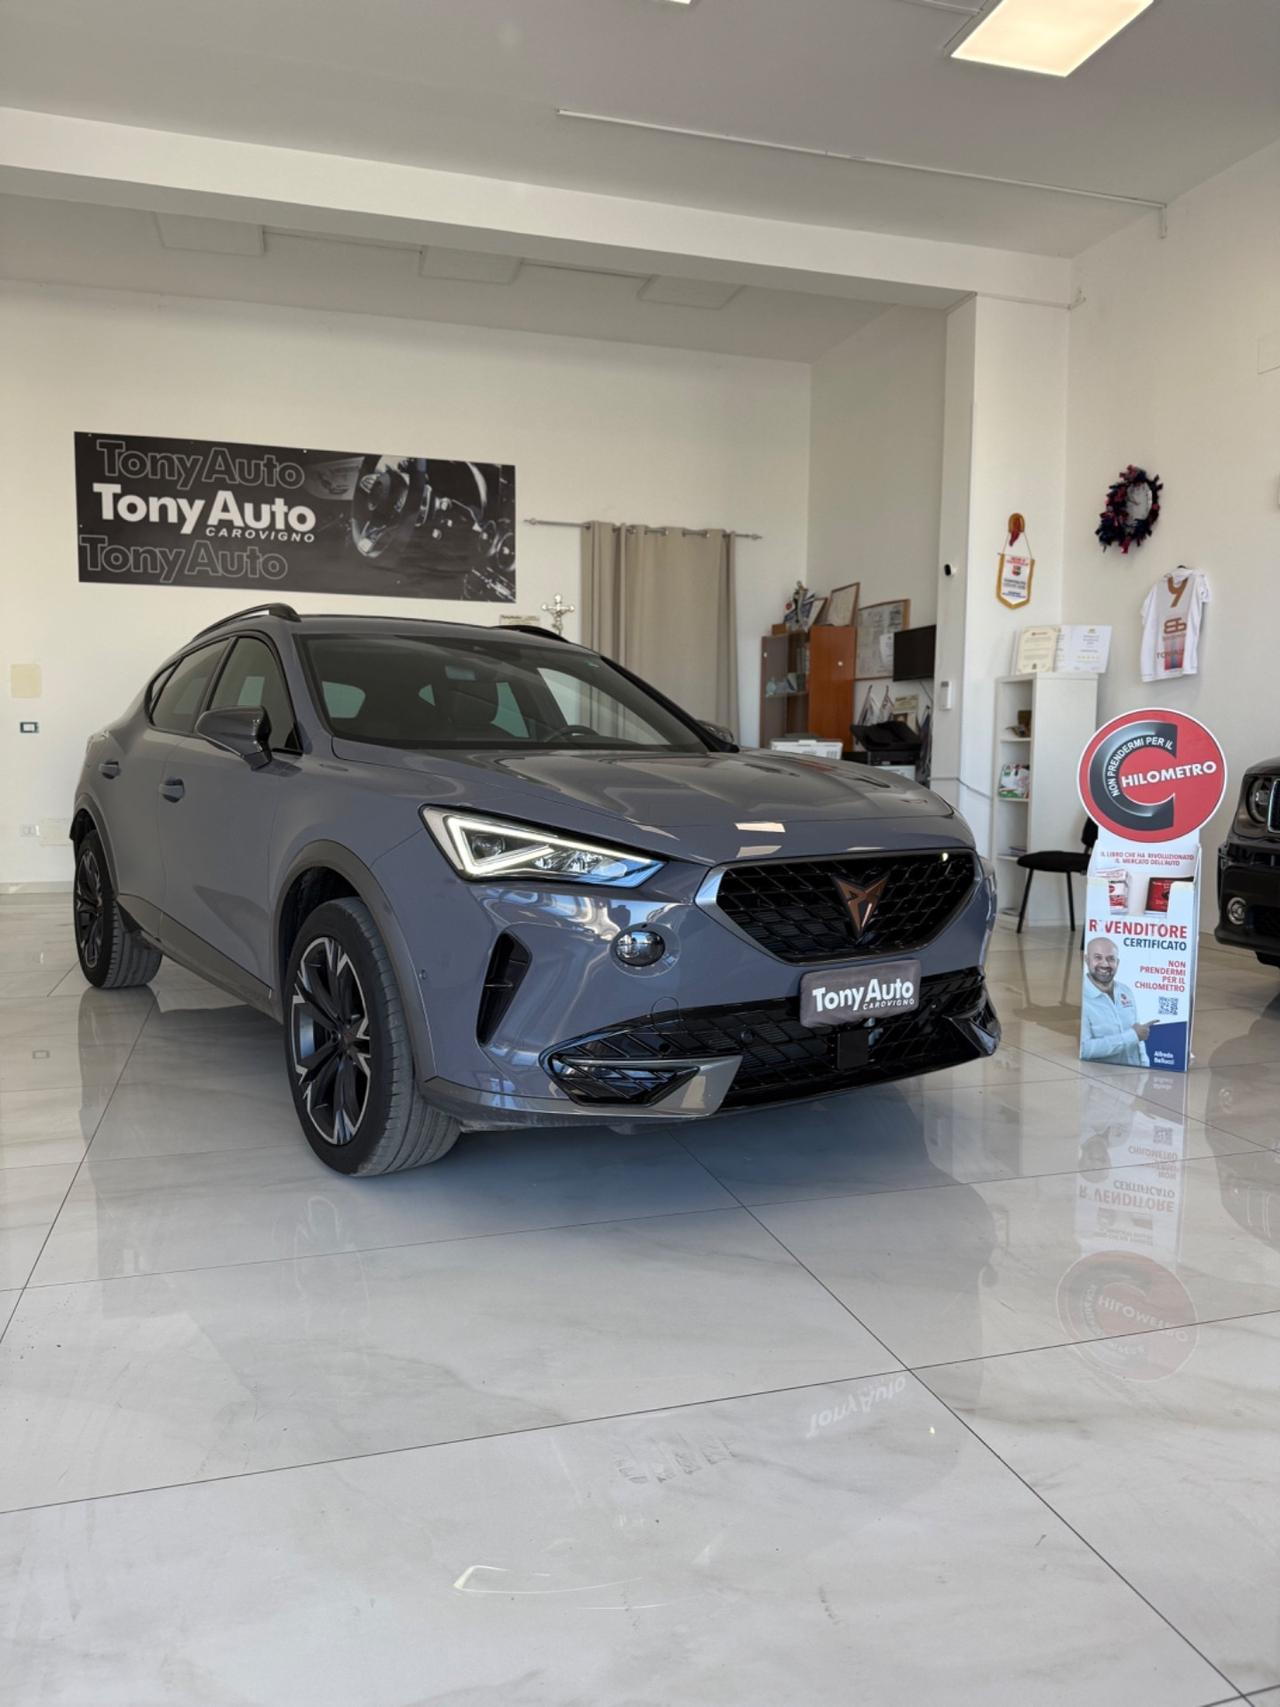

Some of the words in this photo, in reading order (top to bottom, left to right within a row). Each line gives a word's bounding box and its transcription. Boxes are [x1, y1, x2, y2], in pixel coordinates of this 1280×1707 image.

[205, 526, 315, 543] CAROVIGNO
[1146, 736, 1165, 746] PER
[1165, 740, 1173, 750] IL
[1107, 739, 1144, 776] PRENDERMI
[1121, 761, 1217, 787] HILOMETRO
[1107, 777, 1120, 797] NON
[1147, 852, 1194, 860] RIVOLUZIONATO
[1123, 937, 1187, 951] CERTIFICATO
[1168, 960, 1186, 968] NON
[1140, 965, 1186, 976] PRENDERMI
[1135, 980, 1185, 992] CHILOMETRO
[862, 998, 915, 1010] CAROVIGNO
